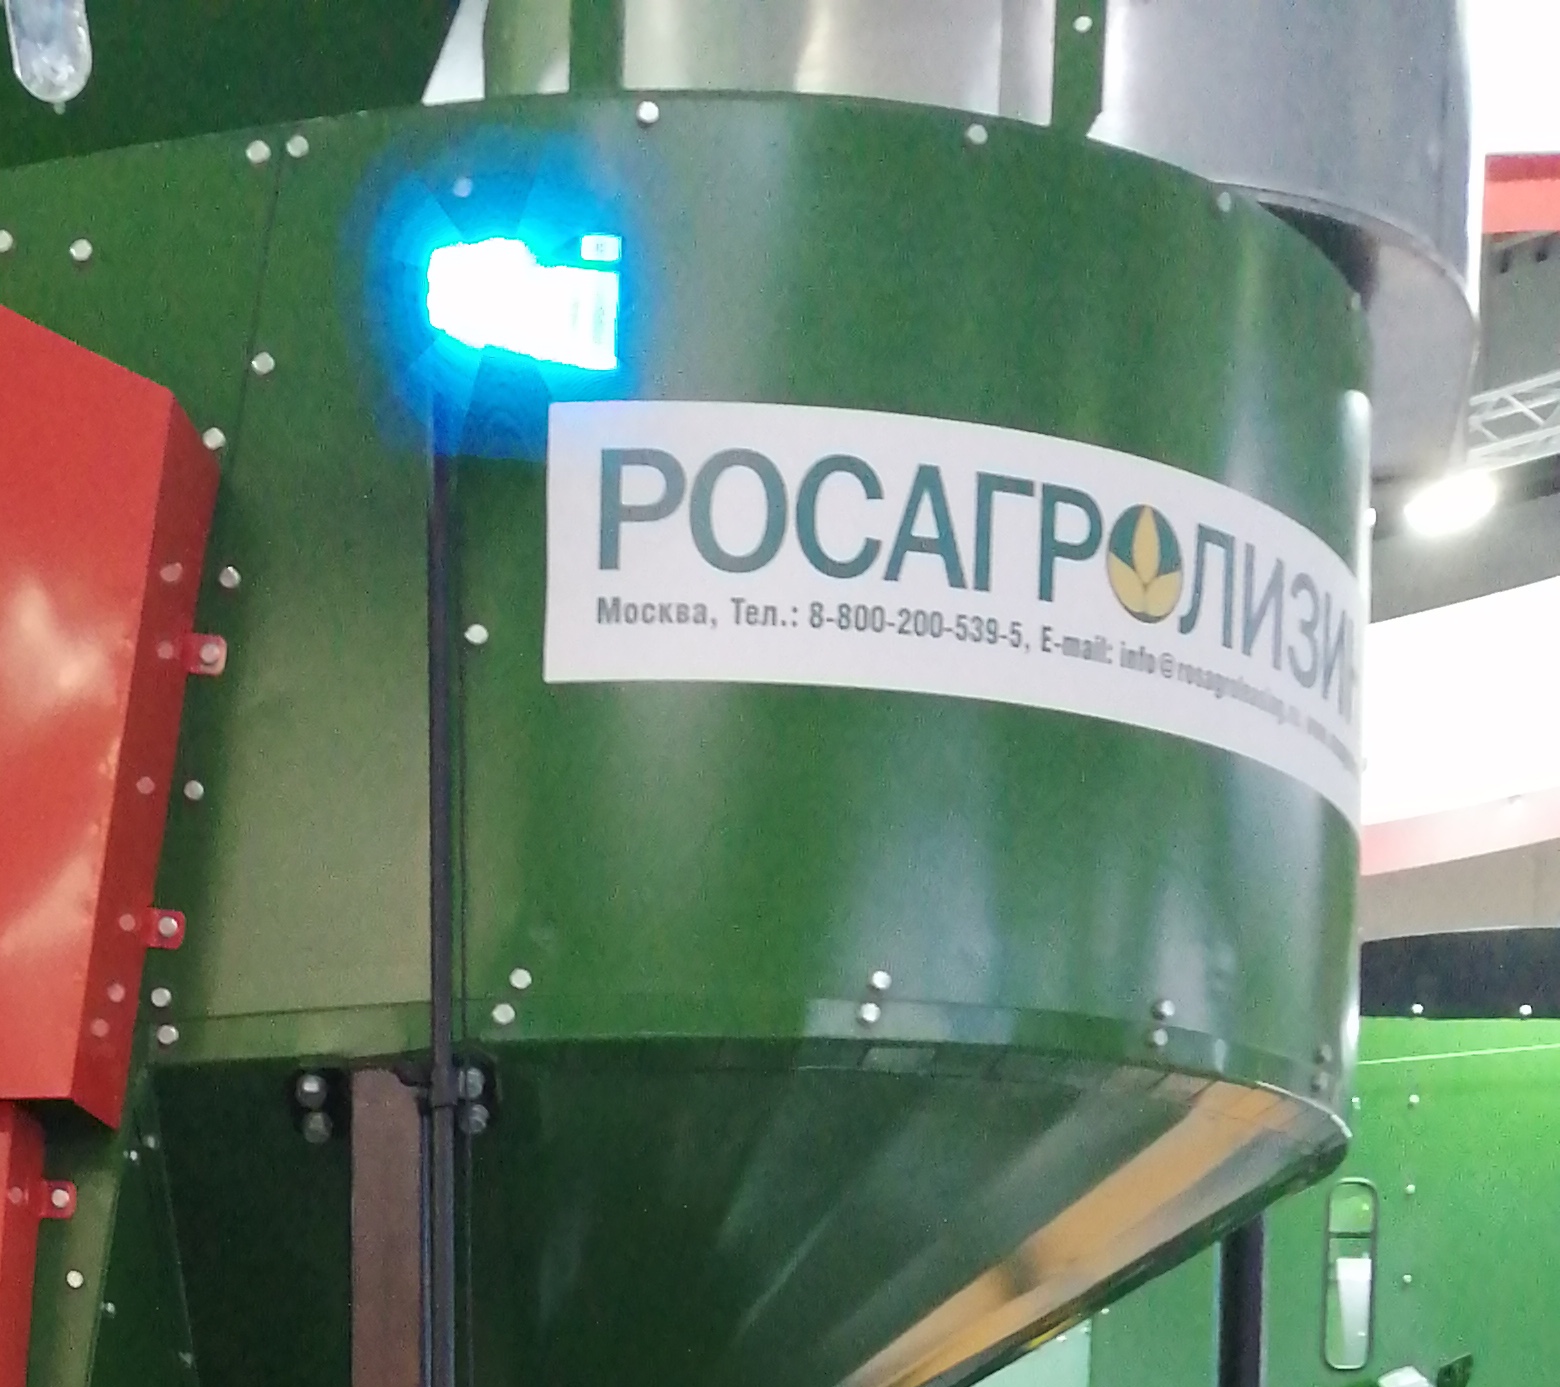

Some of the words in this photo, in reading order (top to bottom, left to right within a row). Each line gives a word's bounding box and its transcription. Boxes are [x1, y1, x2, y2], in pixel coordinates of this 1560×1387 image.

[597, 597, 718, 627] Москва,
[731, 597, 799, 628] Тел.:
[809, 601, 1031, 652] 8-800-200-539-5,
[1041, 625, 1112, 664] E-mail:
